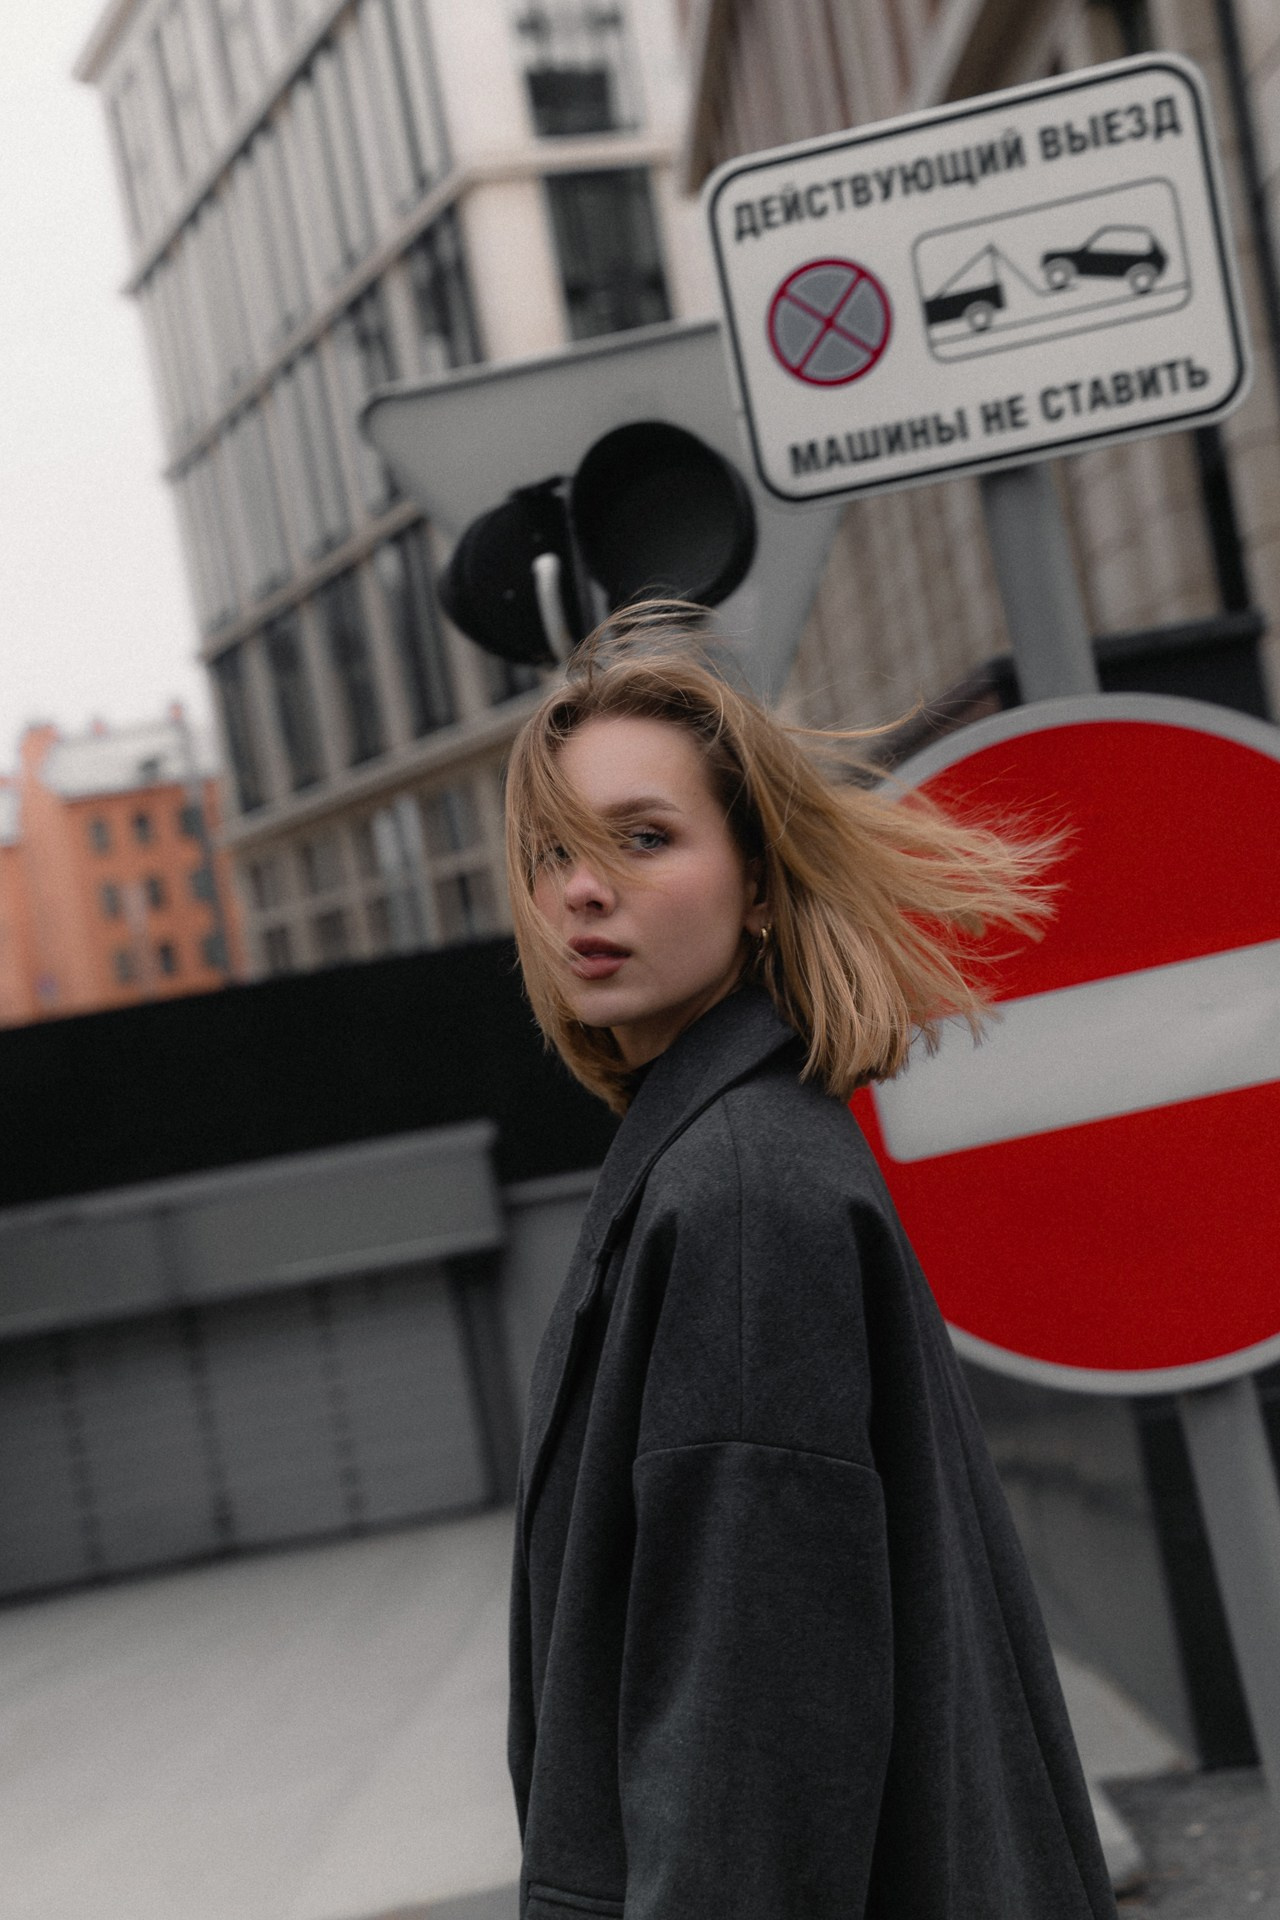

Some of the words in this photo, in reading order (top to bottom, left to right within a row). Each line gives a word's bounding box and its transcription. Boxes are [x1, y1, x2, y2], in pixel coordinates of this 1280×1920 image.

[734, 129, 1026, 242] ДЕЙСТВУЮЩИЙ
[1039, 96, 1182, 161] ВЫЕЗД
[789, 408, 968, 477] МАШИНЫ
[981, 394, 1028, 433] НЕ
[1040, 357, 1210, 422] СТАВИТЬ
